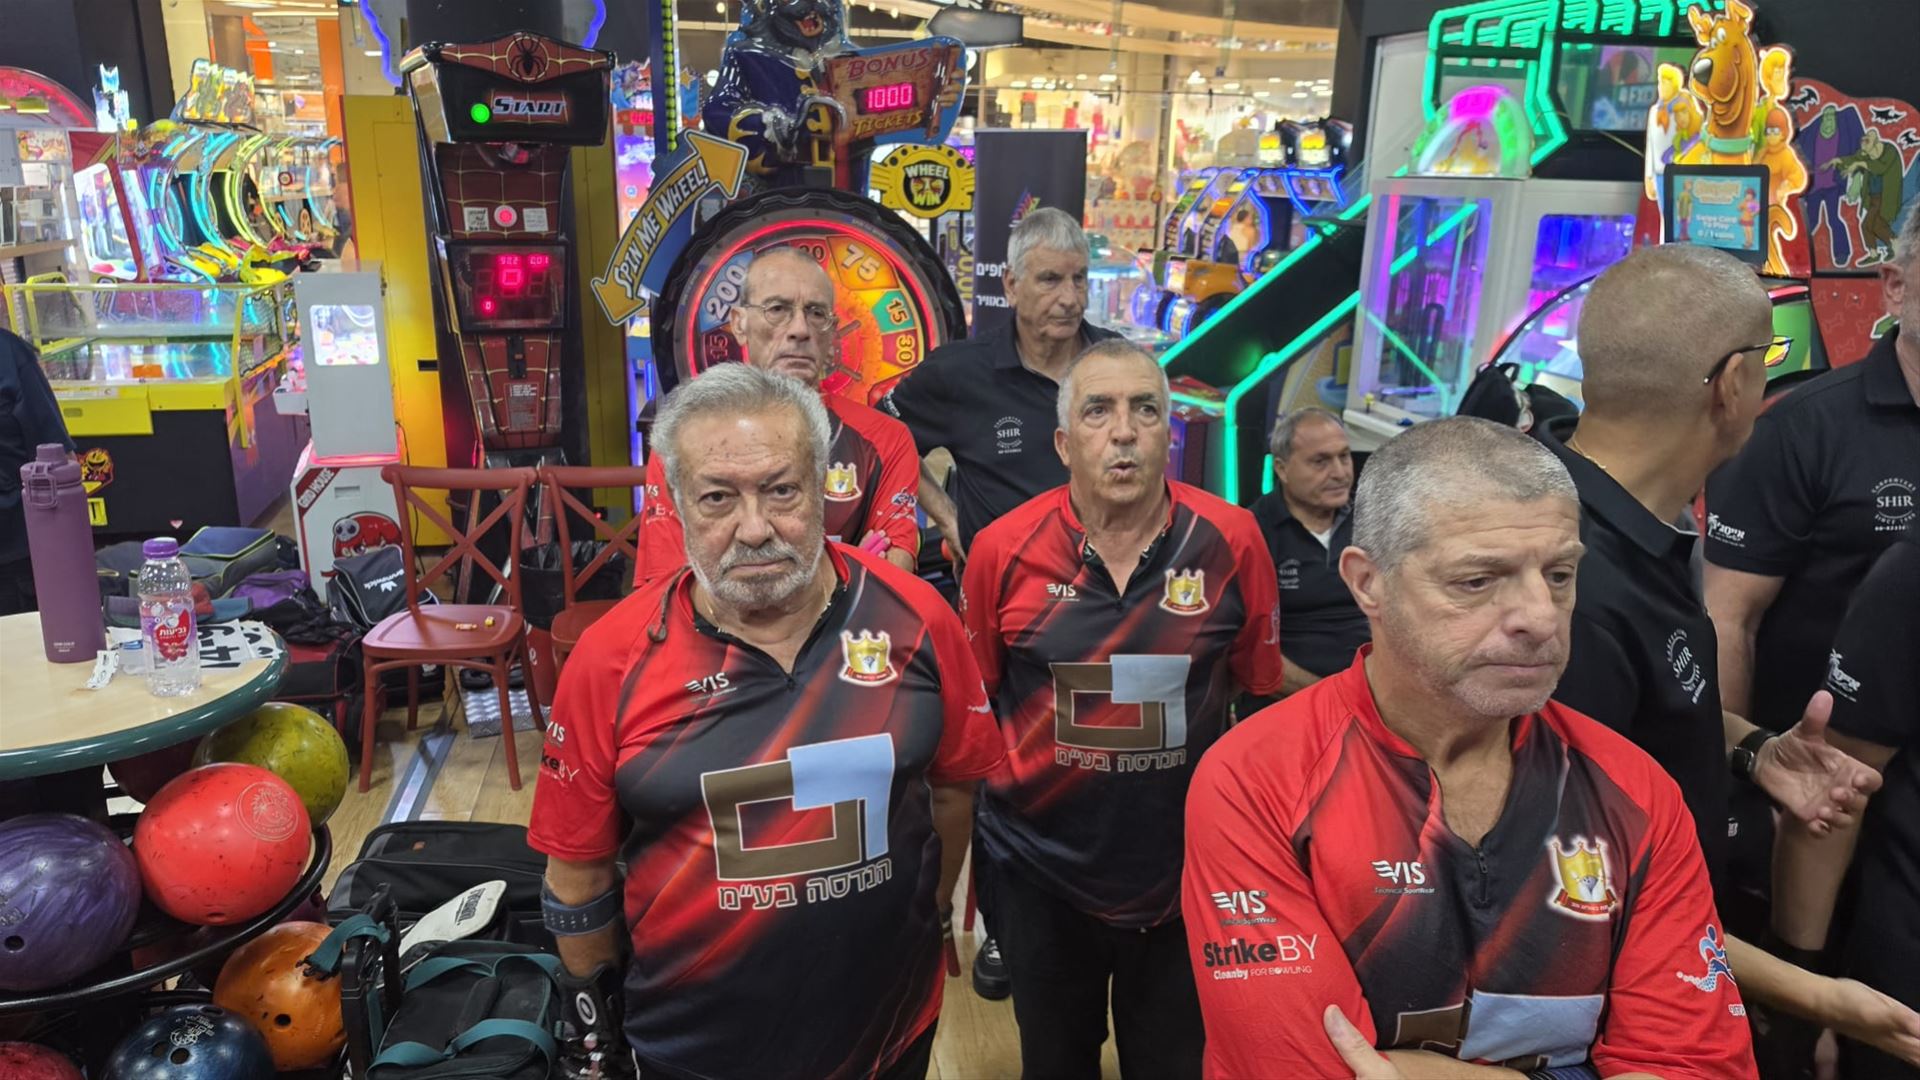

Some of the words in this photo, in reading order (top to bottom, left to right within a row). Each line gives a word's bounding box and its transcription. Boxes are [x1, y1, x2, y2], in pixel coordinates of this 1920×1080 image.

[849, 49, 929, 80] BONUS
[493, 96, 566, 115] START
[868, 84, 913, 108] 1000
[853, 111, 923, 136] TICKETS
[904, 163, 950, 180] WHEEL
[912, 189, 942, 206] WIN
[614, 237, 645, 299] SPIN
[636, 211, 662, 250] ME
[655, 157, 711, 223] WHEEL!
[840, 243, 881, 282] 75
[704, 263, 748, 322] 200
[884, 296, 908, 326] 15
[895, 333, 916, 365] 30
[996, 428, 1021, 439] SHIR
[1876, 495, 1914, 508] SHIR
[1046, 583, 1077, 597] VIS
[1672, 646, 1693, 679] SHIR
[684, 672, 730, 693] VIS
[1117, 748, 1187, 773] הנדסה
[806, 858, 893, 904] הנדסה
[1371, 860, 1426, 885] VIS
[1211, 889, 1267, 915] VIS
[1203, 934, 1318, 968] StrikeBY
[1250, 967, 1268, 977] FOR
[1269, 965, 1313, 975] BOWLING
